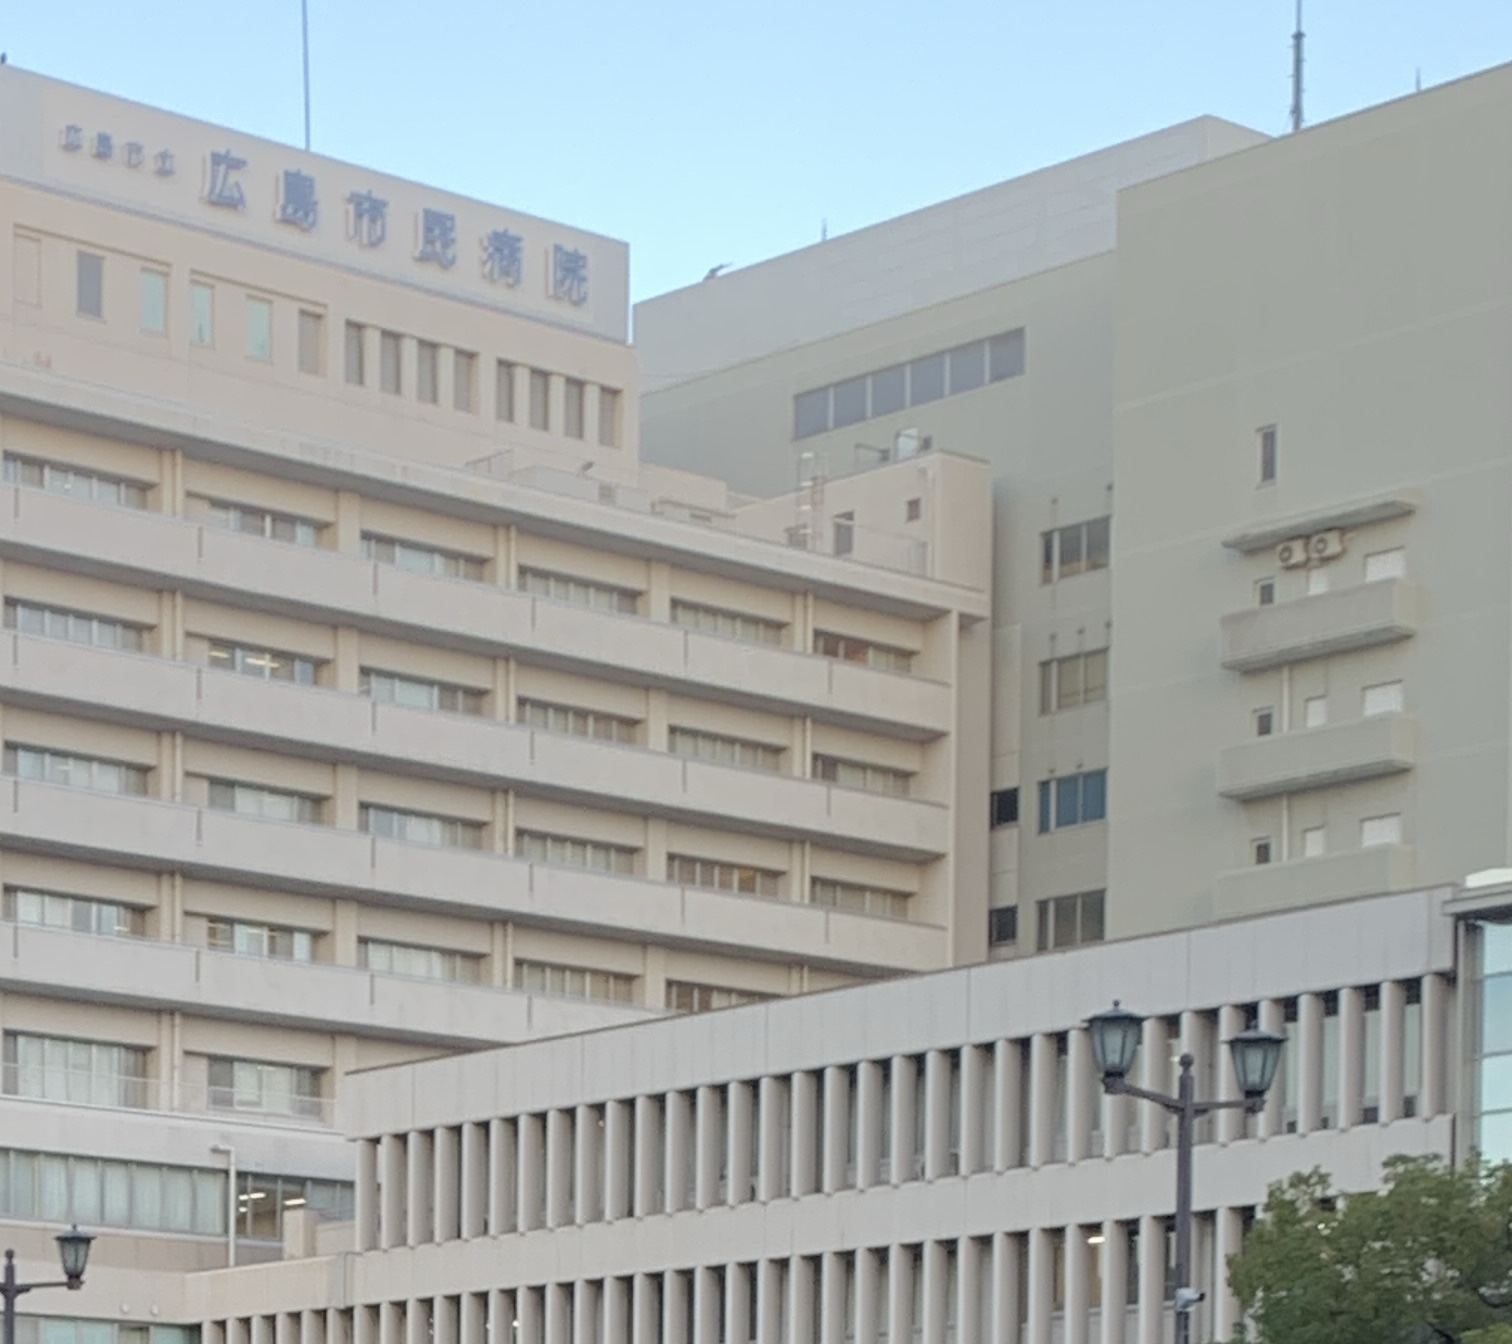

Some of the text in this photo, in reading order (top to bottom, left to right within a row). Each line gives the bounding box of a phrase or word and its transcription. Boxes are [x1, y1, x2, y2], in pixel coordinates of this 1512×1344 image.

[202, 149, 589, 306] 広島市民病院
